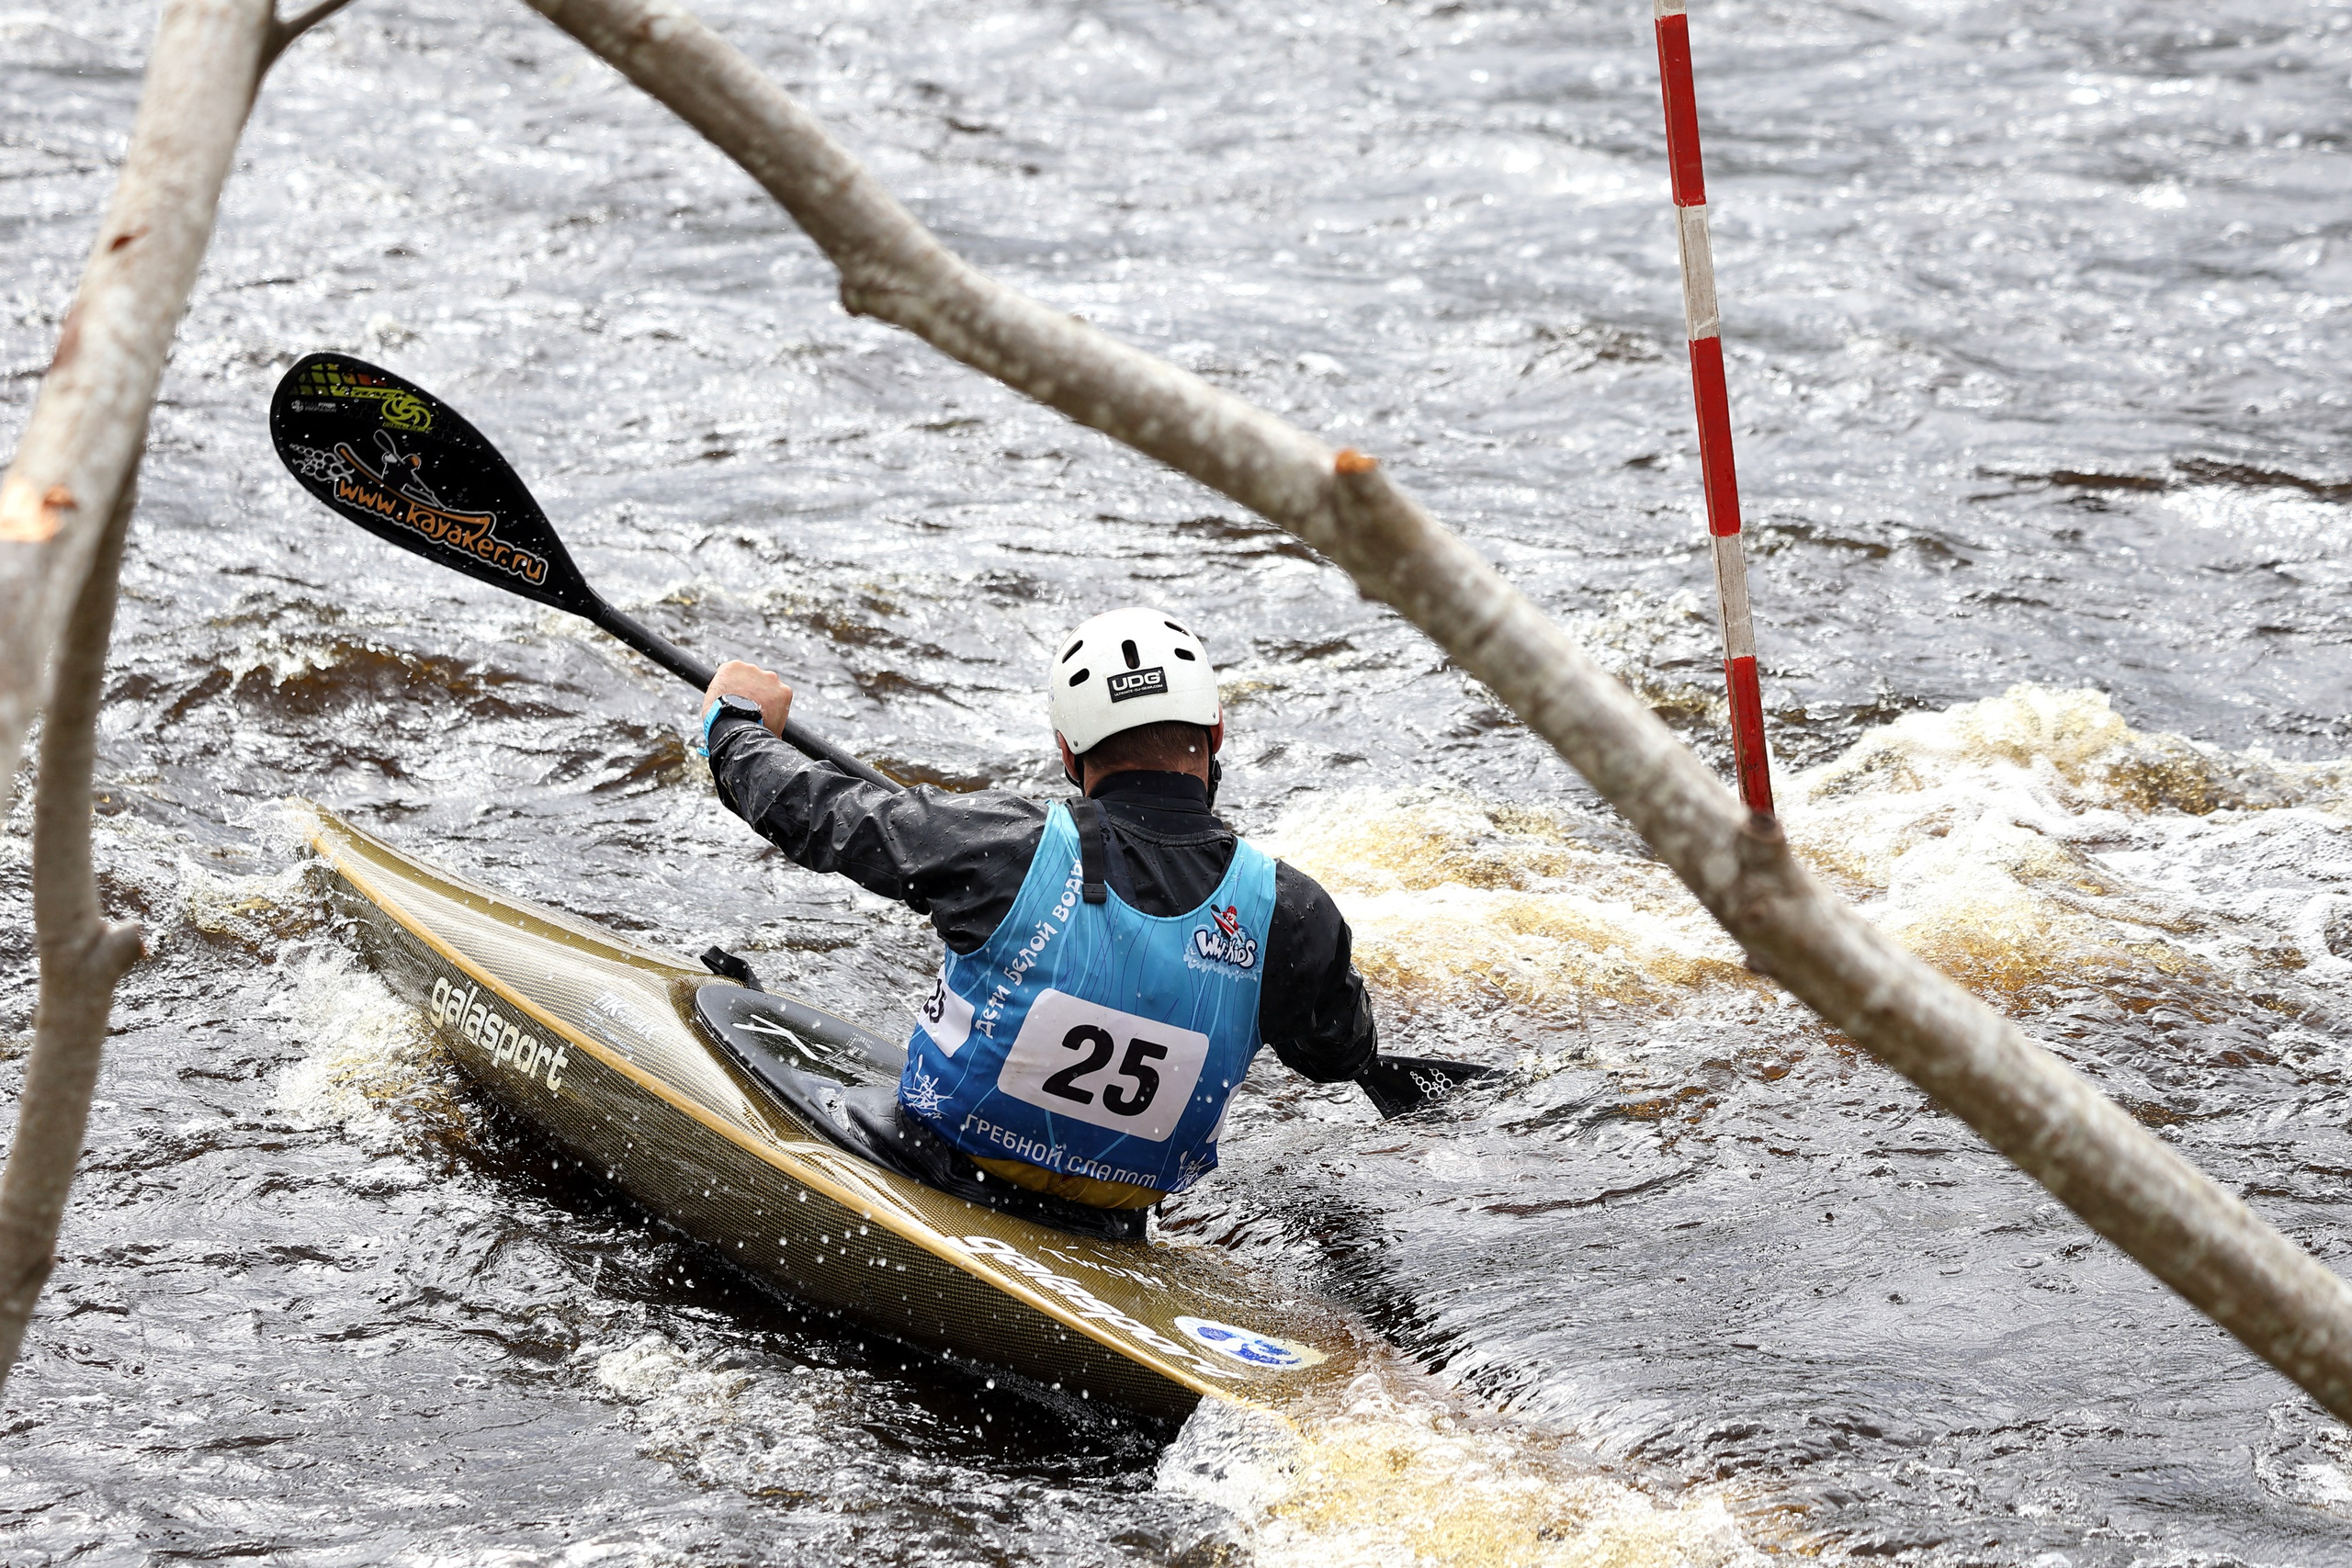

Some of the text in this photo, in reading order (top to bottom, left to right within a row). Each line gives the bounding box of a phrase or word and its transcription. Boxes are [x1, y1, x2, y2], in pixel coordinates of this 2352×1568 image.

[1112, 671, 1160, 691] UDG
[429, 976, 570, 1091] galasport
[1042, 1023, 1168, 1117] 25
[965, 1113, 1065, 1168] ГРЕБНОЙ
